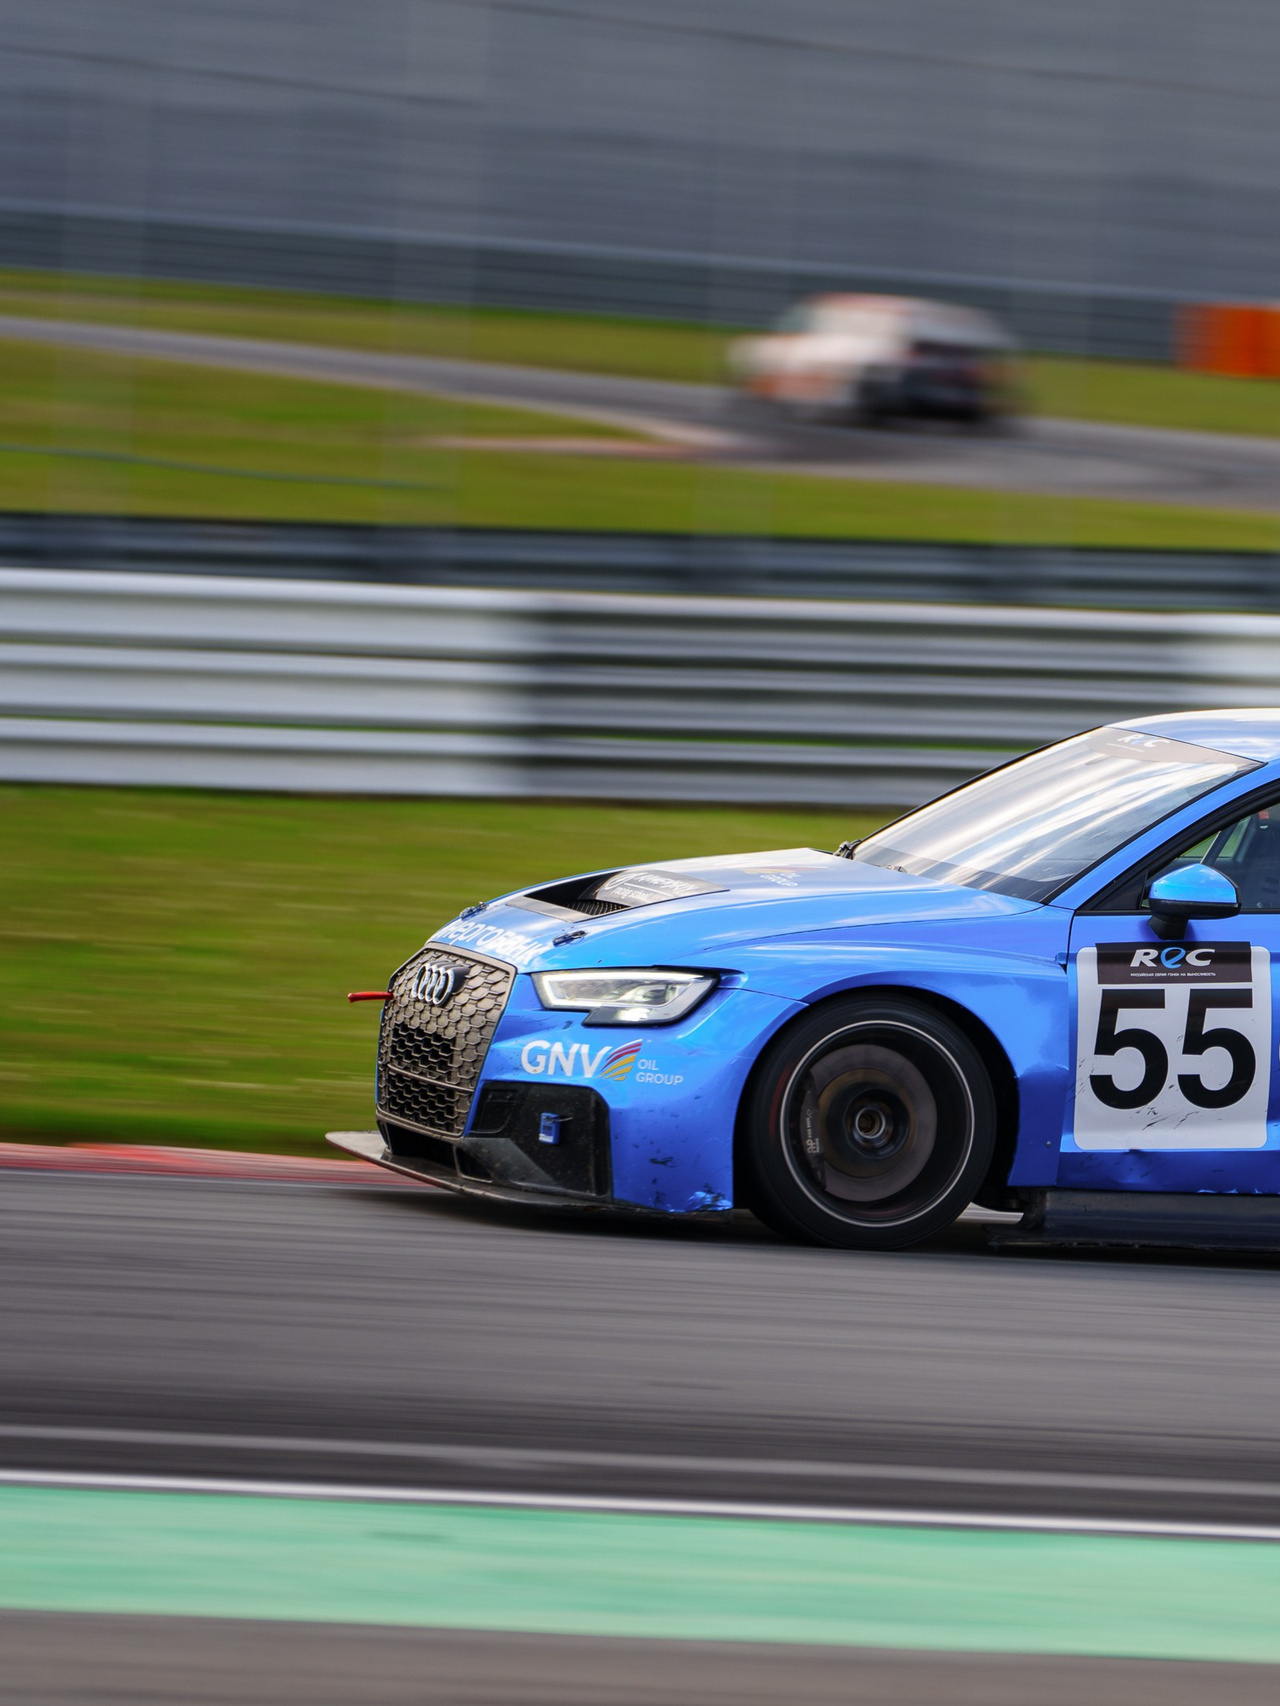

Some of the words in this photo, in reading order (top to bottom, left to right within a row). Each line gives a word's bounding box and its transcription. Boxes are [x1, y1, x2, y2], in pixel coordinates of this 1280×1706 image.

[521, 1039, 612, 1078] GNV
[1089, 988, 1256, 1110] 55
[638, 1058, 659, 1071] OIL
[636, 1072, 684, 1086] GROUP
